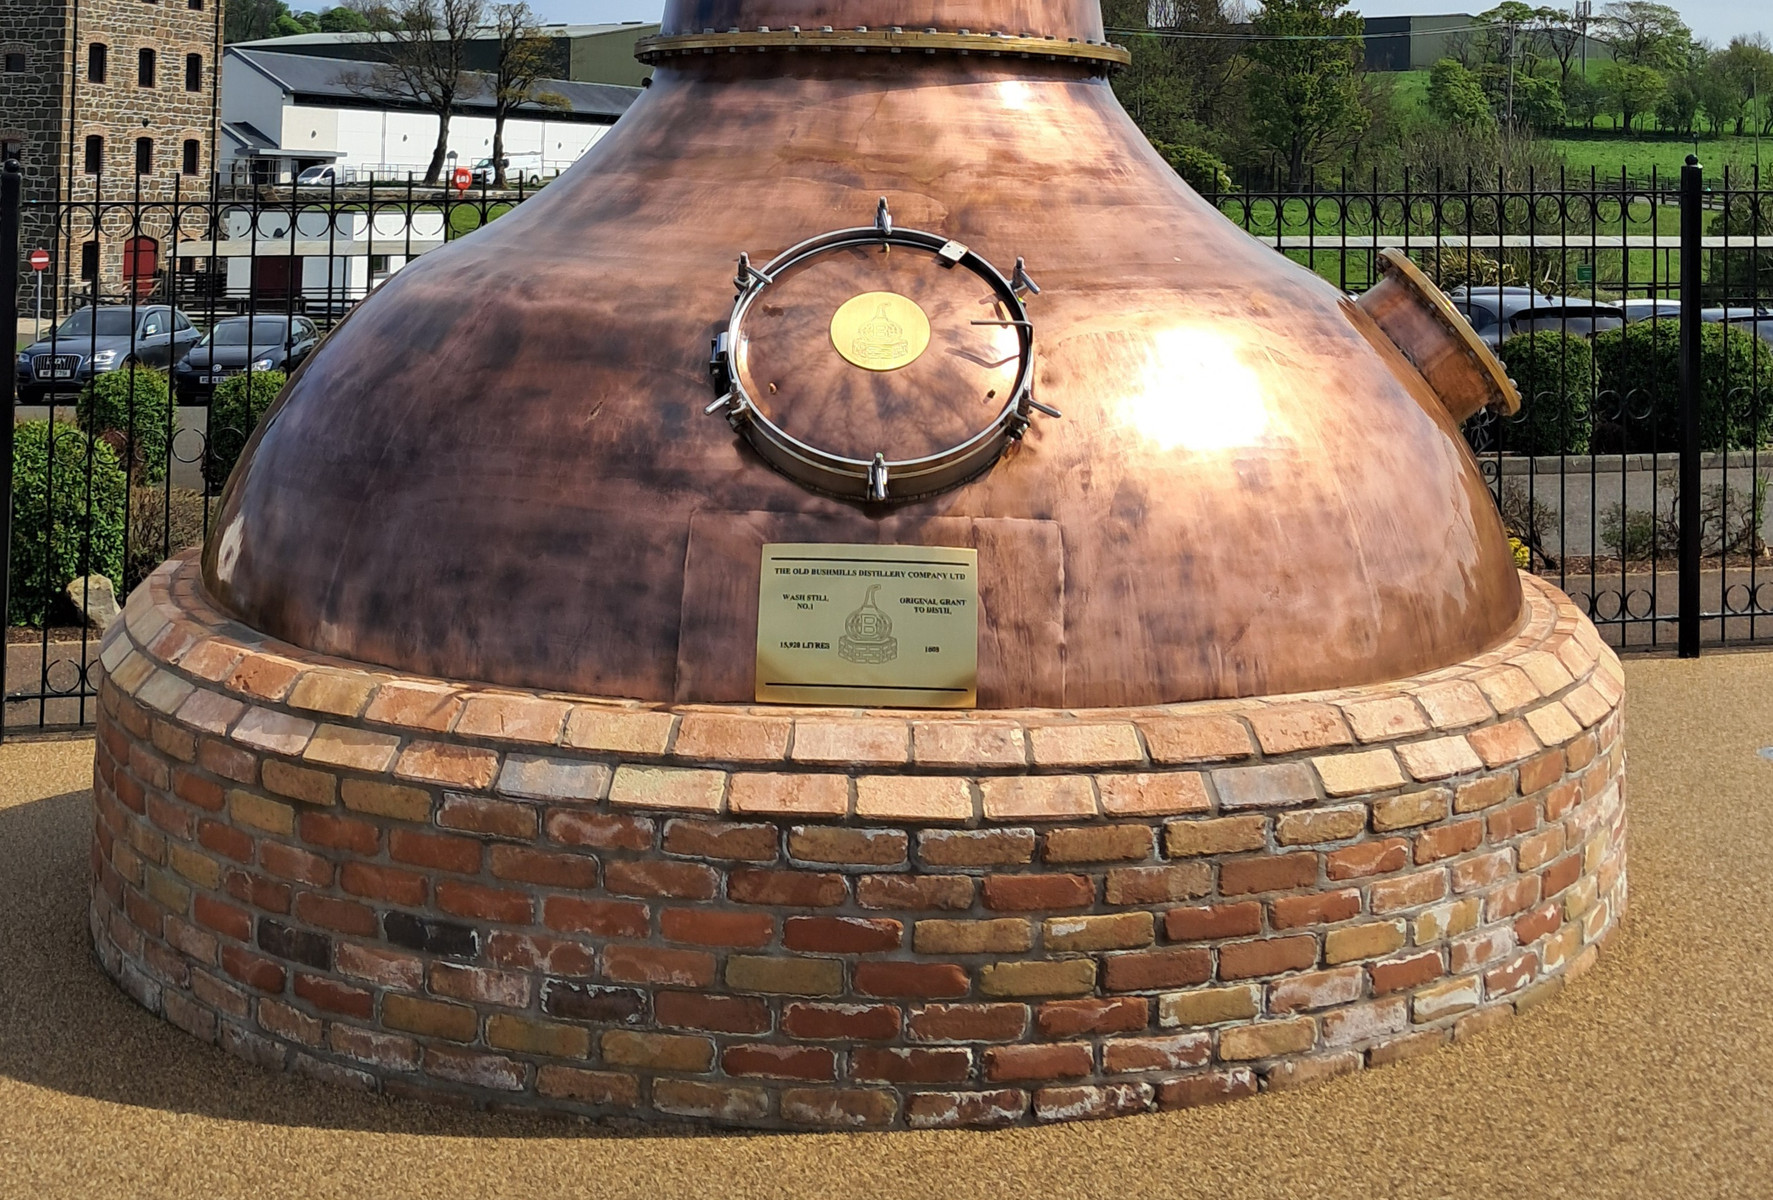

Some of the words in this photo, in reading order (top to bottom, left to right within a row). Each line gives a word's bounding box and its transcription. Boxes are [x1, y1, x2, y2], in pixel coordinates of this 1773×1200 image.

[859, 570, 905, 578] DISTILLERY
[908, 571, 947, 579] COMPANY
[807, 594, 829, 602] STILL
[900, 597, 938, 606] ORIGINAL
[802, 641, 830, 650] LITRES
